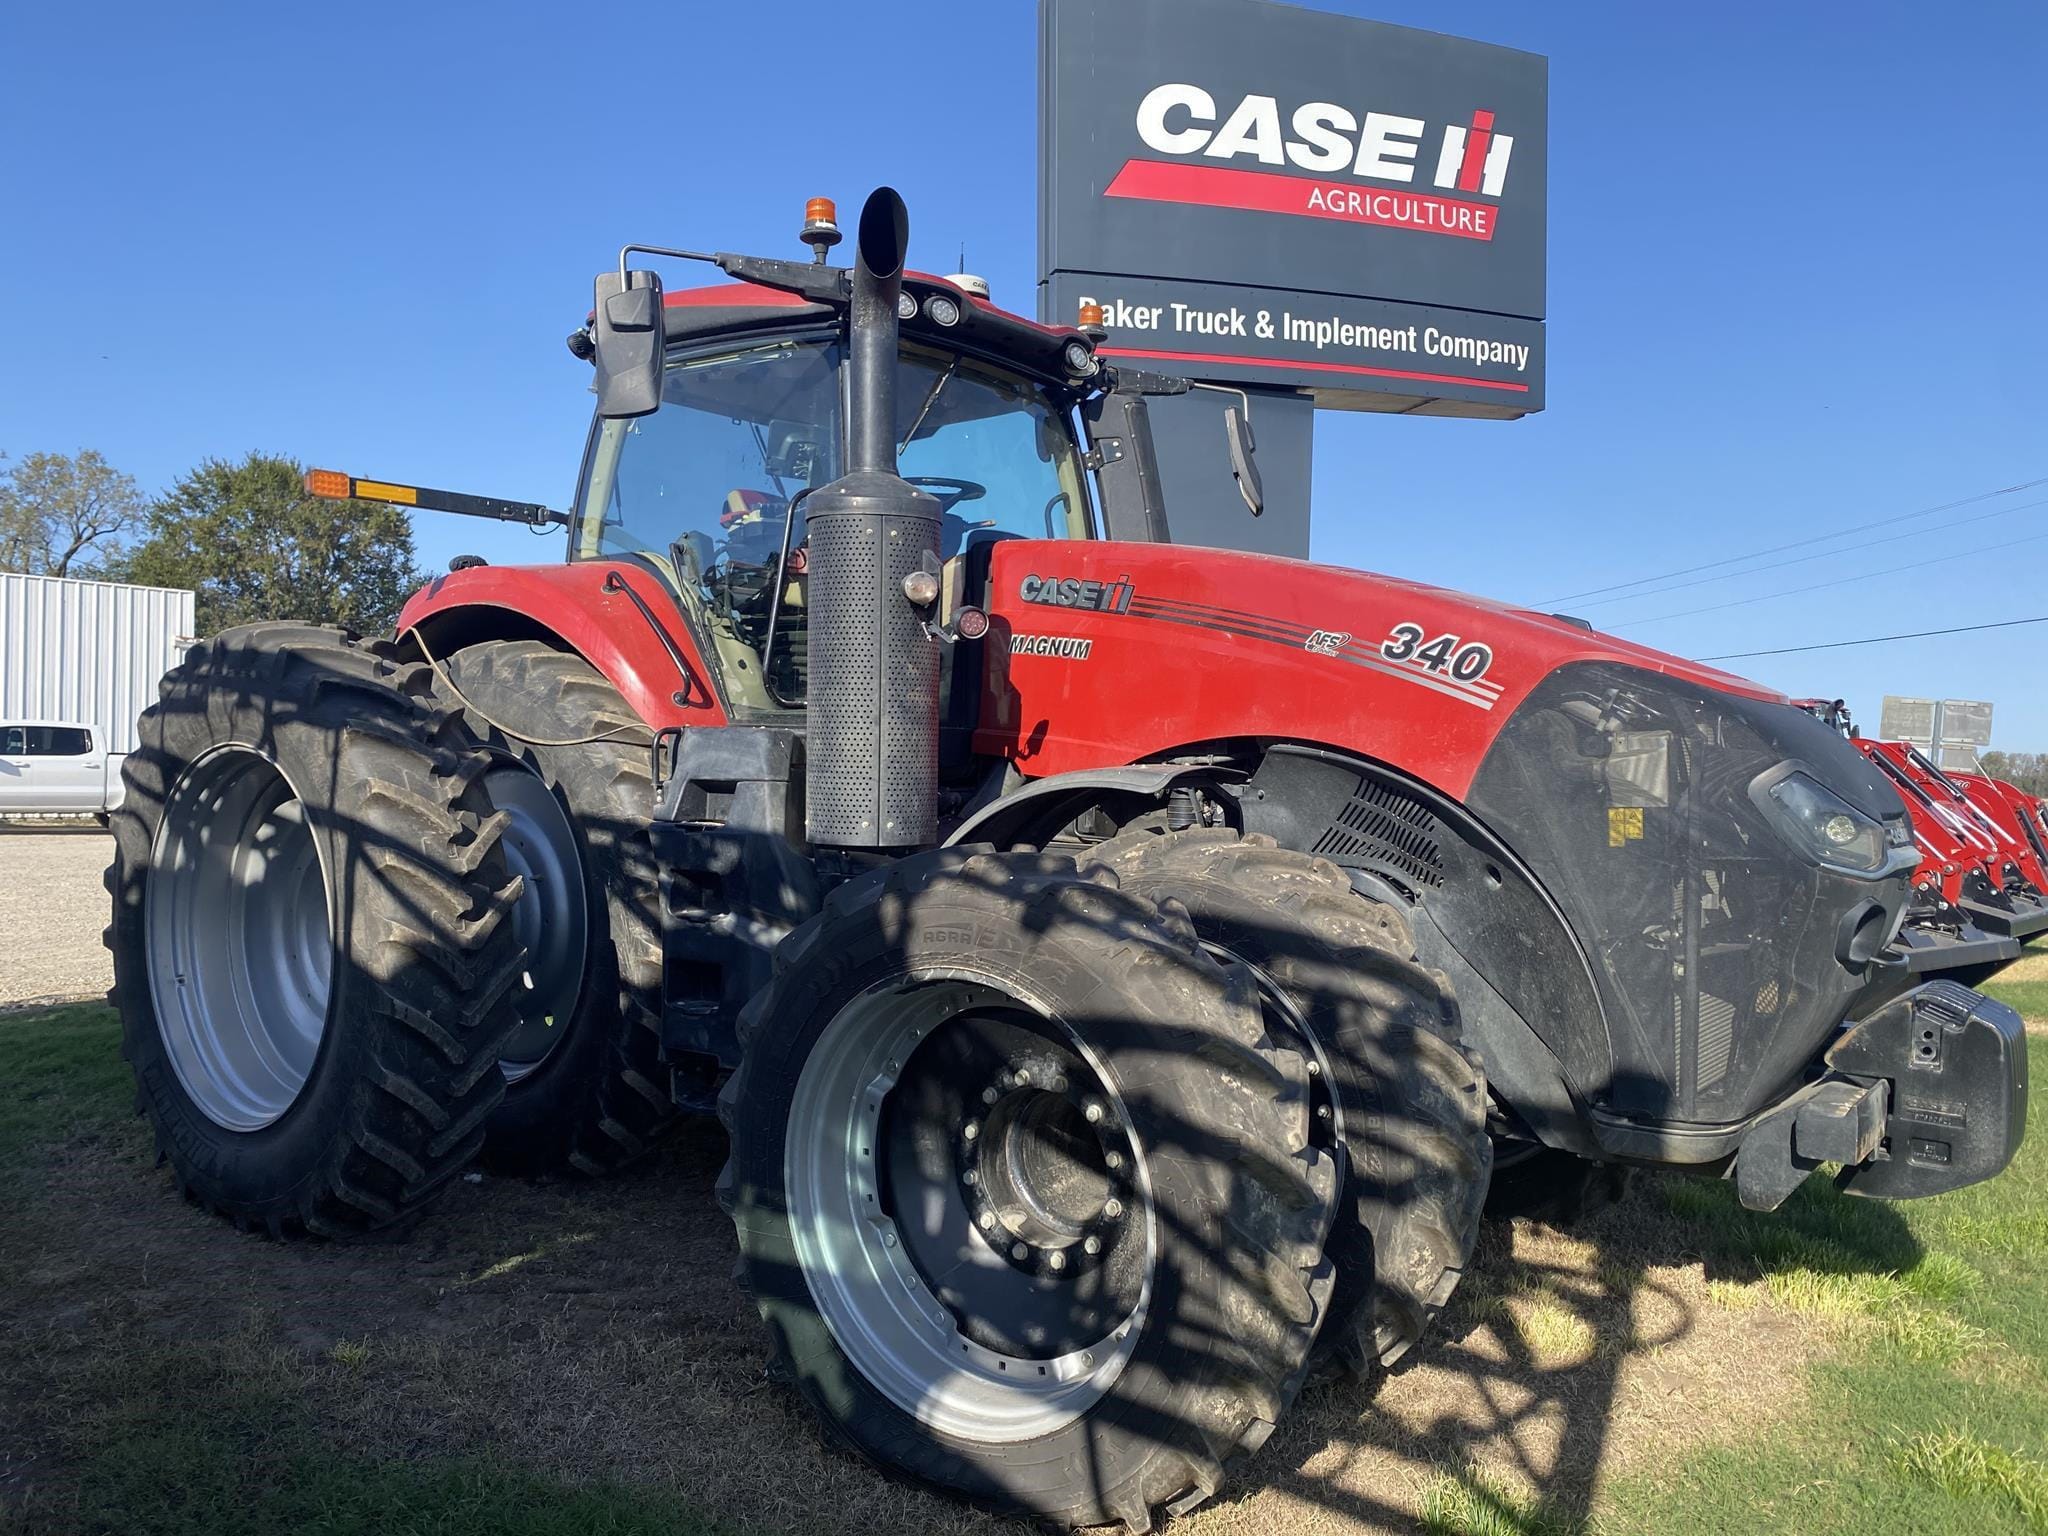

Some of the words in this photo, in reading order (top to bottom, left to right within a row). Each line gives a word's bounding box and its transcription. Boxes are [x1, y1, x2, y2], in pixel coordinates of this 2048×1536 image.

[1136, 83, 1425, 182] CASE
[1307, 187, 1487, 233] AGRICULTURE
[1170, 303, 1247, 337] Truck
[1254, 310, 1275, 339] &
[1283, 312, 1417, 353] Implement
[1424, 327, 1530, 372] Company
[1020, 574, 1101, 611] CASE
[1008, 634, 1093, 660] MAGNUM
[1306, 630, 1342, 649] AFS
[1381, 622, 1493, 684] 340
